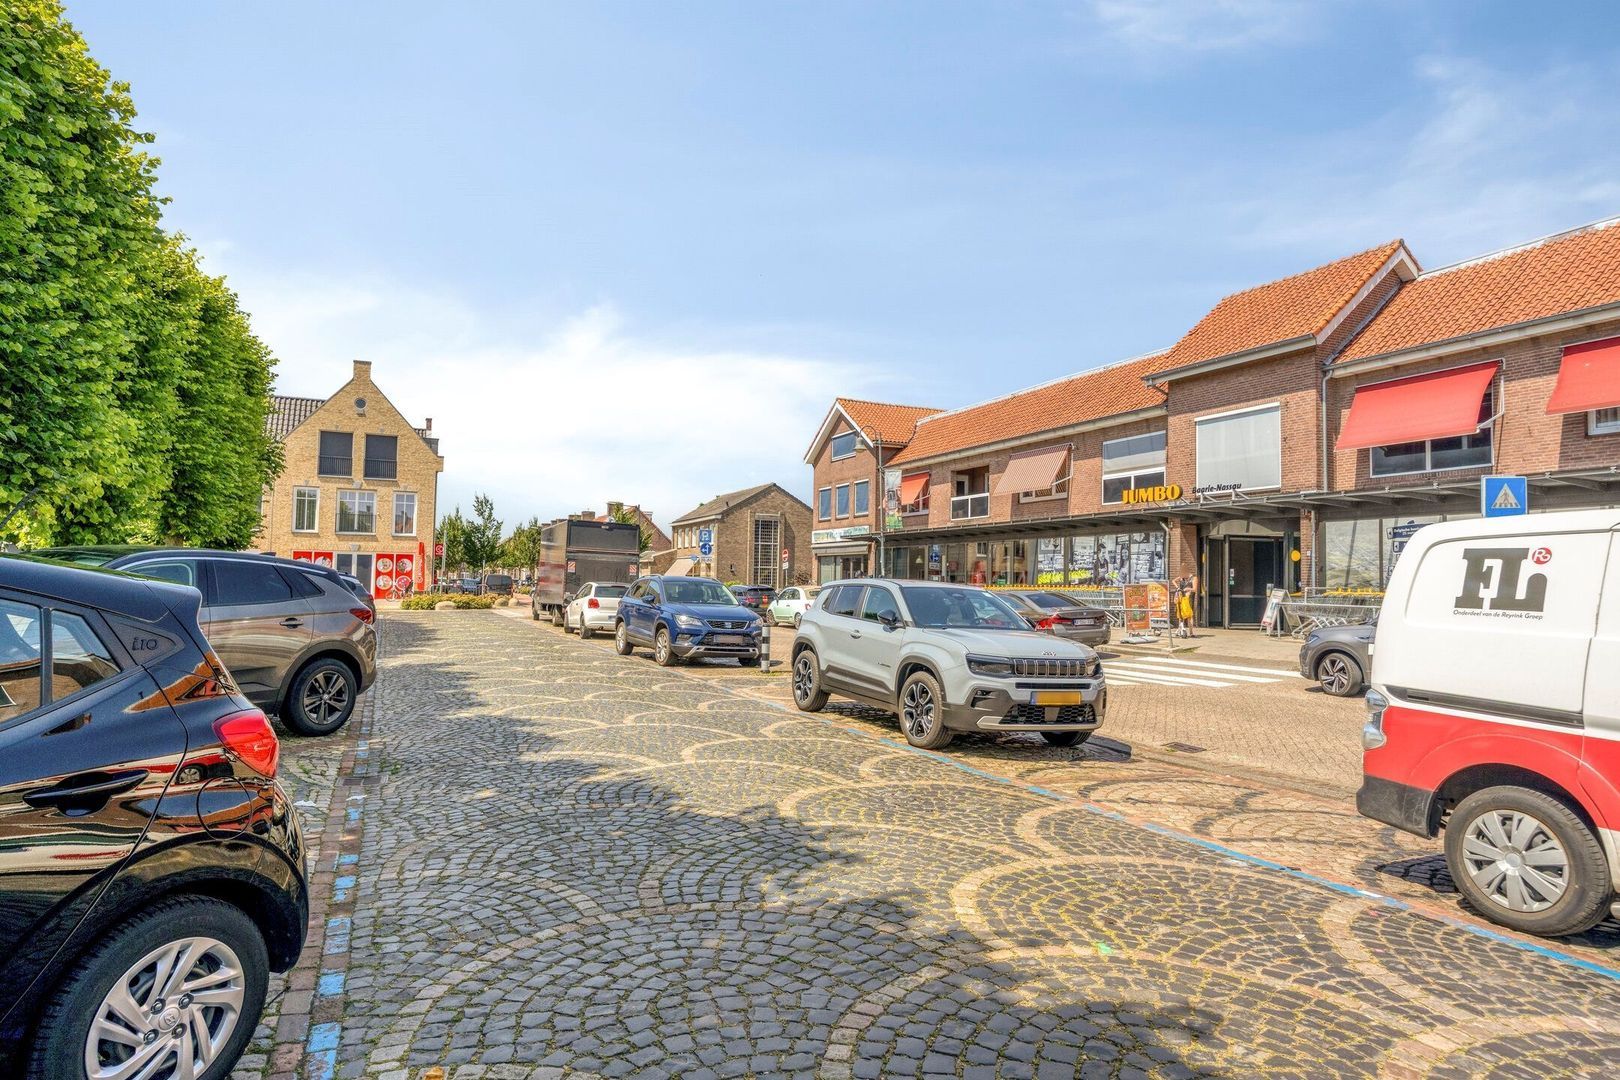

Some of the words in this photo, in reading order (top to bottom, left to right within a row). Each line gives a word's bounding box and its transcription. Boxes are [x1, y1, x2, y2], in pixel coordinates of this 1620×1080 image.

[1122, 483, 1182, 504] JUMBO
[1192, 483, 1242, 494] Baarle-Nassau
[1453, 609, 1482, 617] Onderdeel
[132, 637, 157, 650] i10
